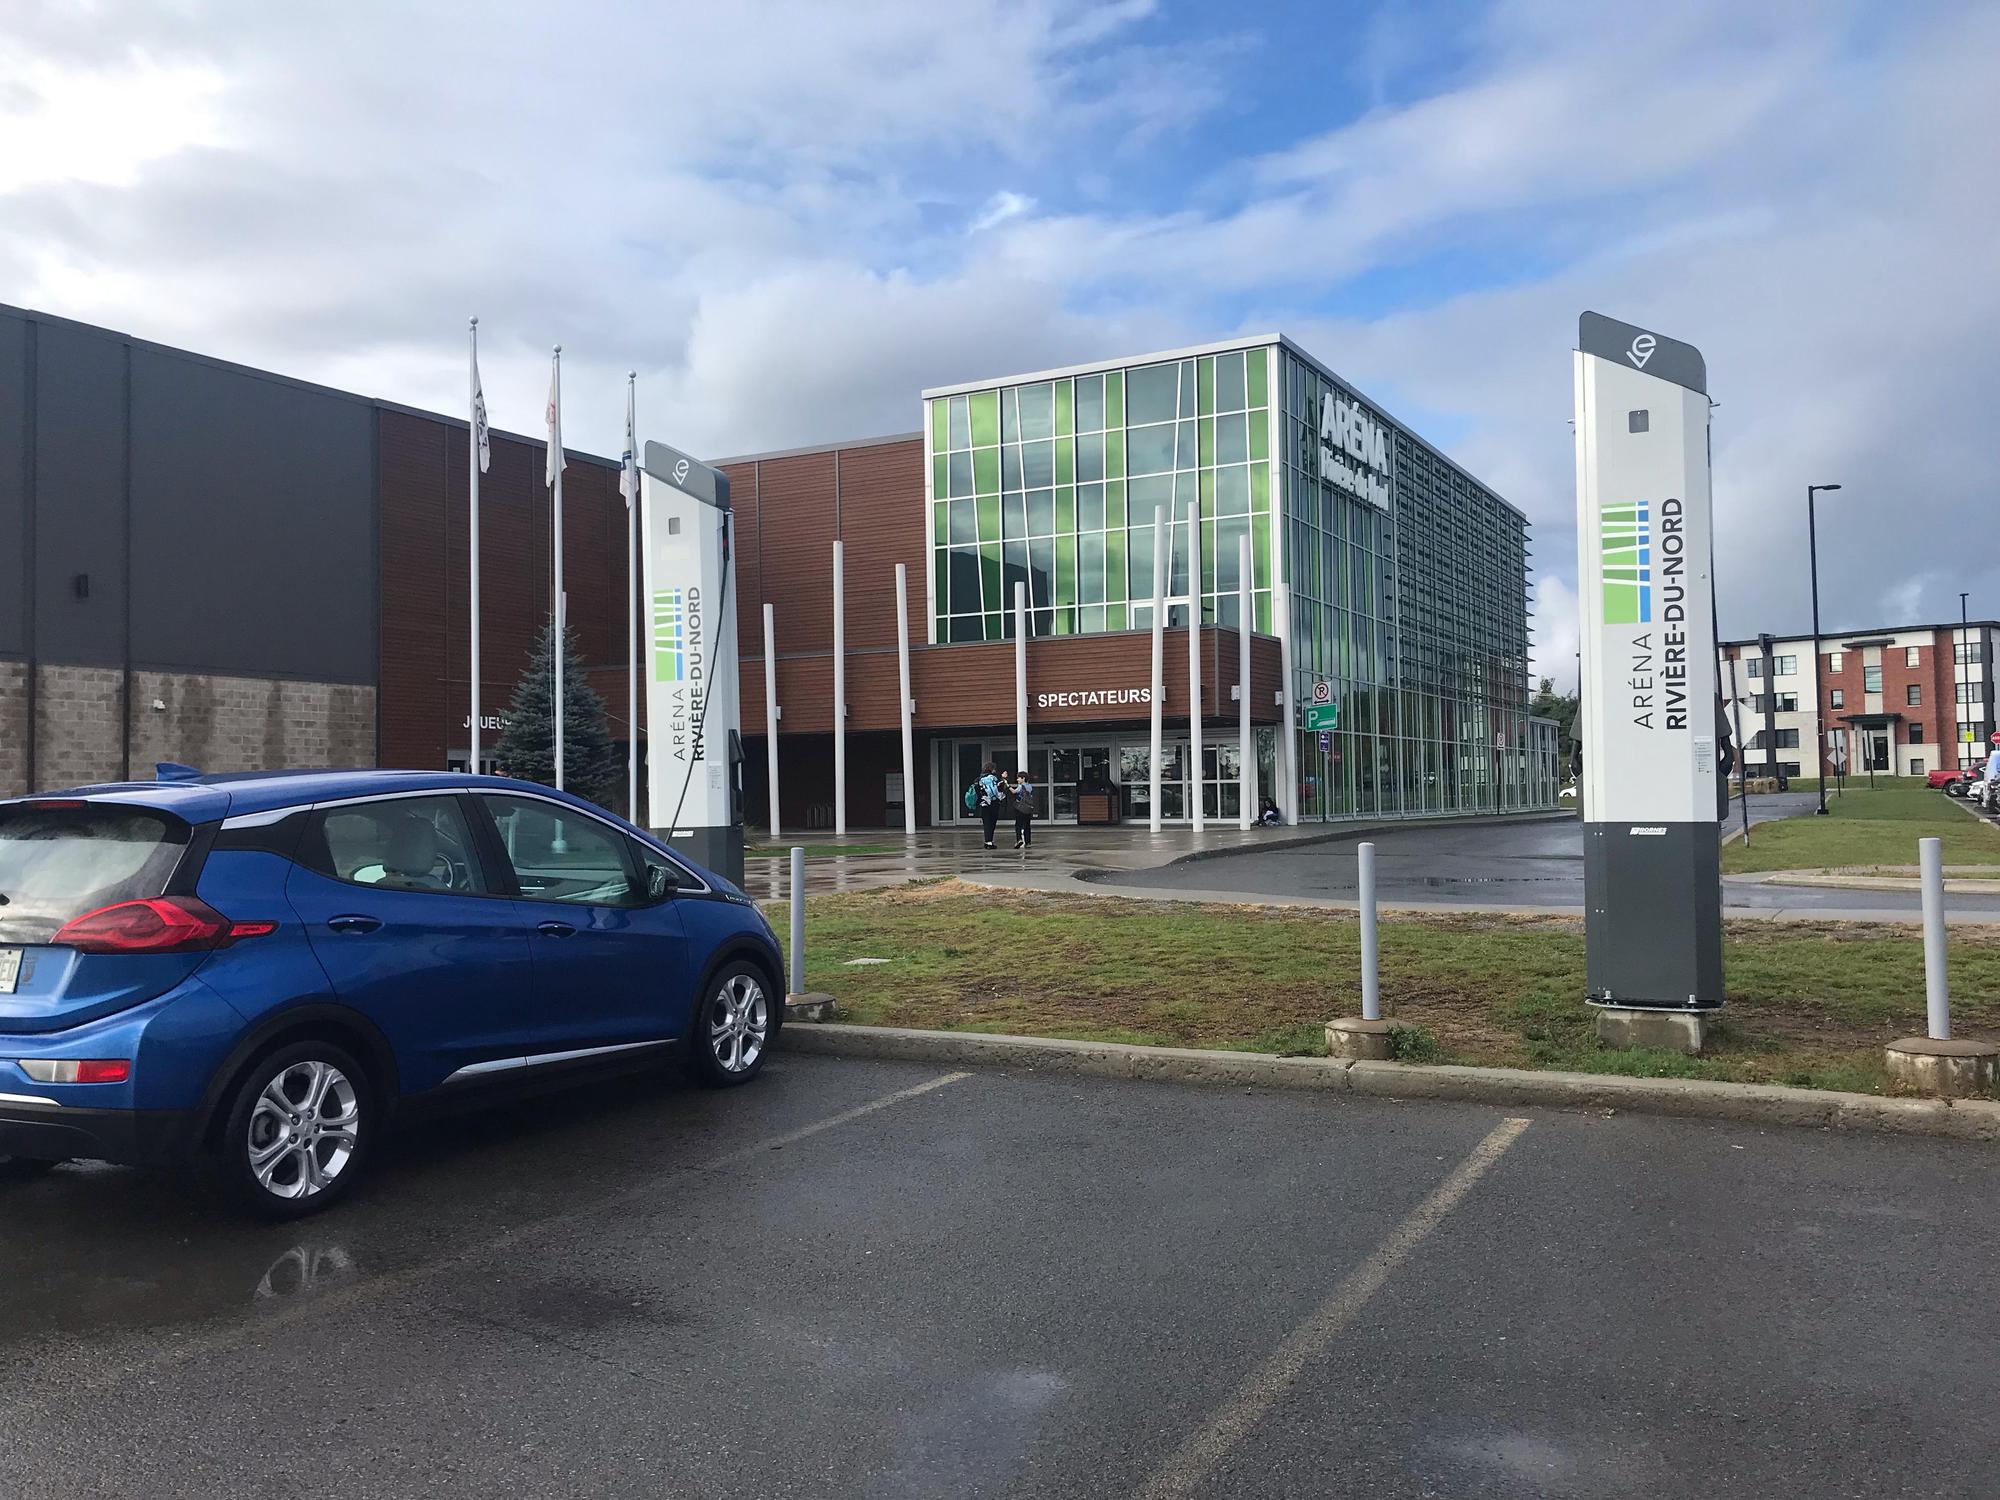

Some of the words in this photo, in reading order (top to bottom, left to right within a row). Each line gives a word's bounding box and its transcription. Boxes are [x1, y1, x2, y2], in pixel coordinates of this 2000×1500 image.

[1321, 392, 1388, 476] ARÉNA
[1660, 498, 1687, 730] RIVIÈRE-DU-NORD
[1038, 688, 1151, 708] SPECTATEURS
[1308, 710, 1319, 728] P
[1627, 633, 1654, 730] ARÉNA
[670, 688, 686, 761] ARÉNA
